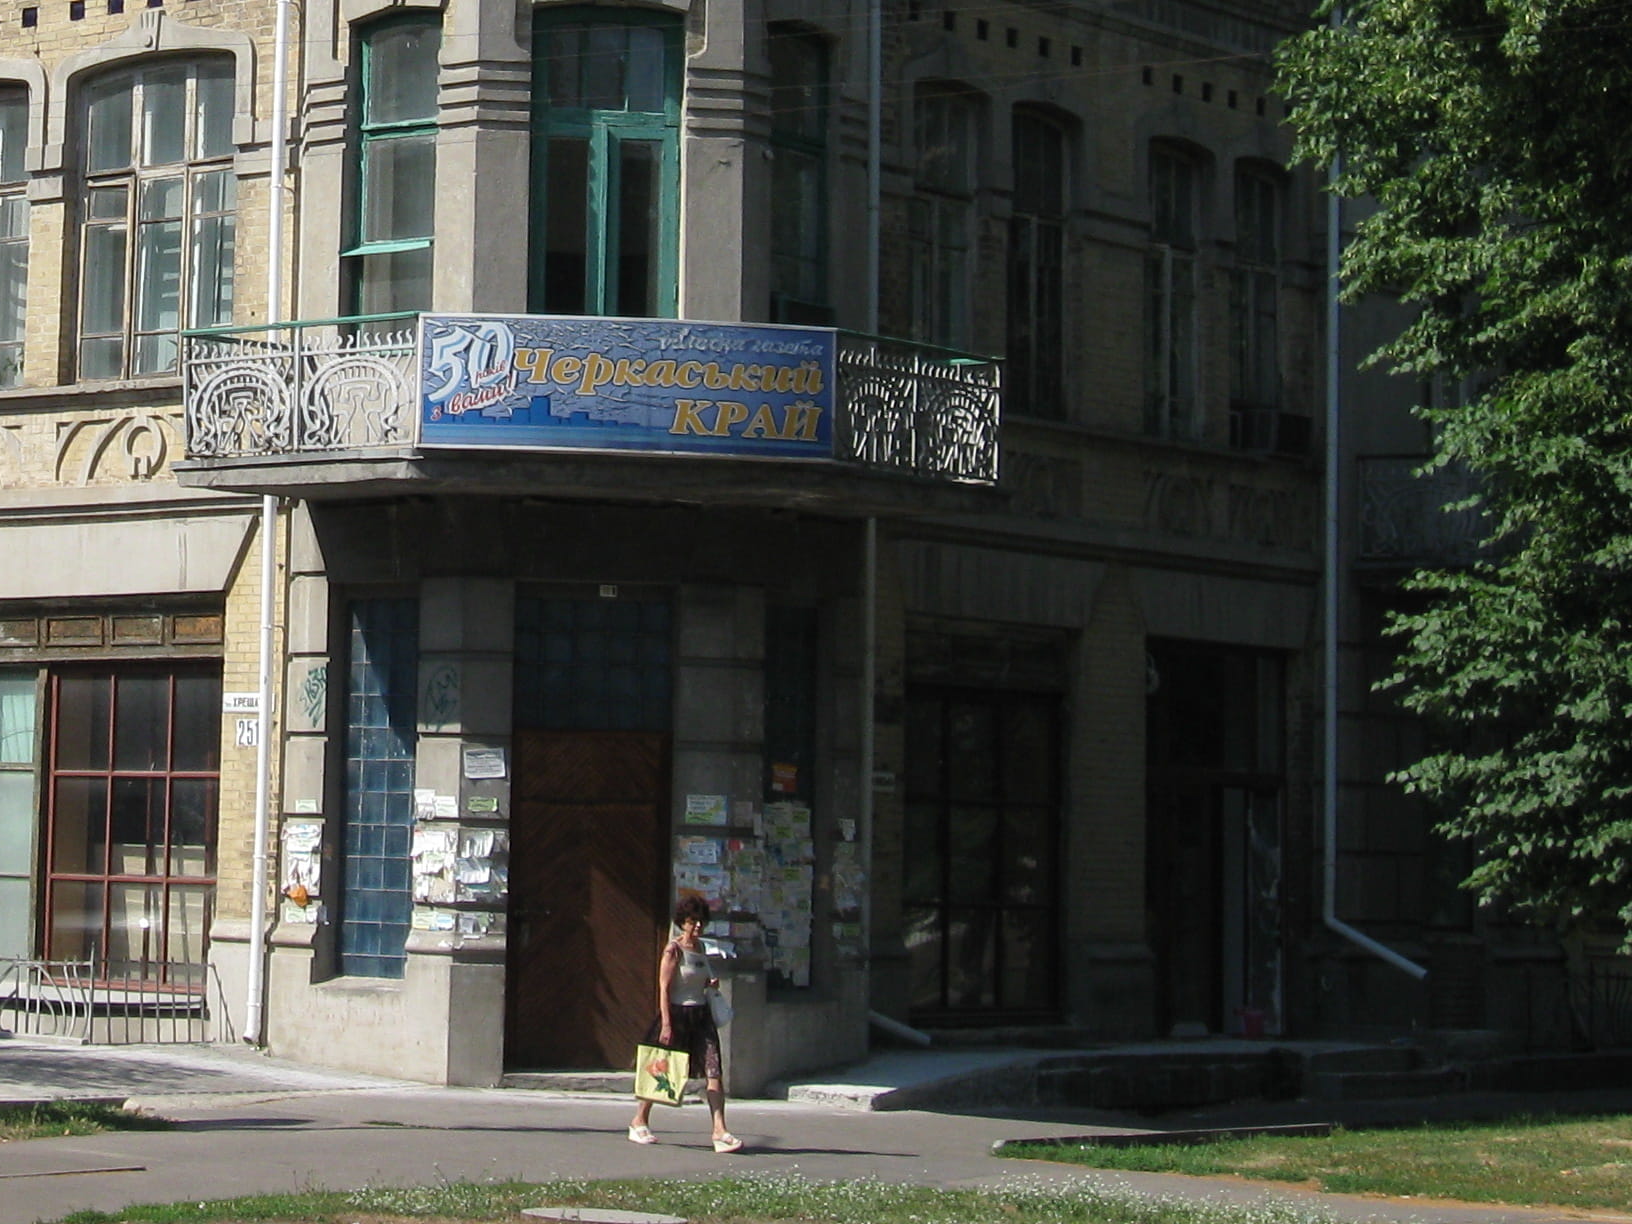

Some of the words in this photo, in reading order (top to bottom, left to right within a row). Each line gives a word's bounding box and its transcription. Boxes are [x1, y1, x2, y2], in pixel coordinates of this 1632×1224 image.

[427, 322, 514, 402] 50
[513, 347, 825, 396] Черкаський
[668, 398, 824, 443] КРАЙ
[233, 697, 260, 707] ХРЕЩА
